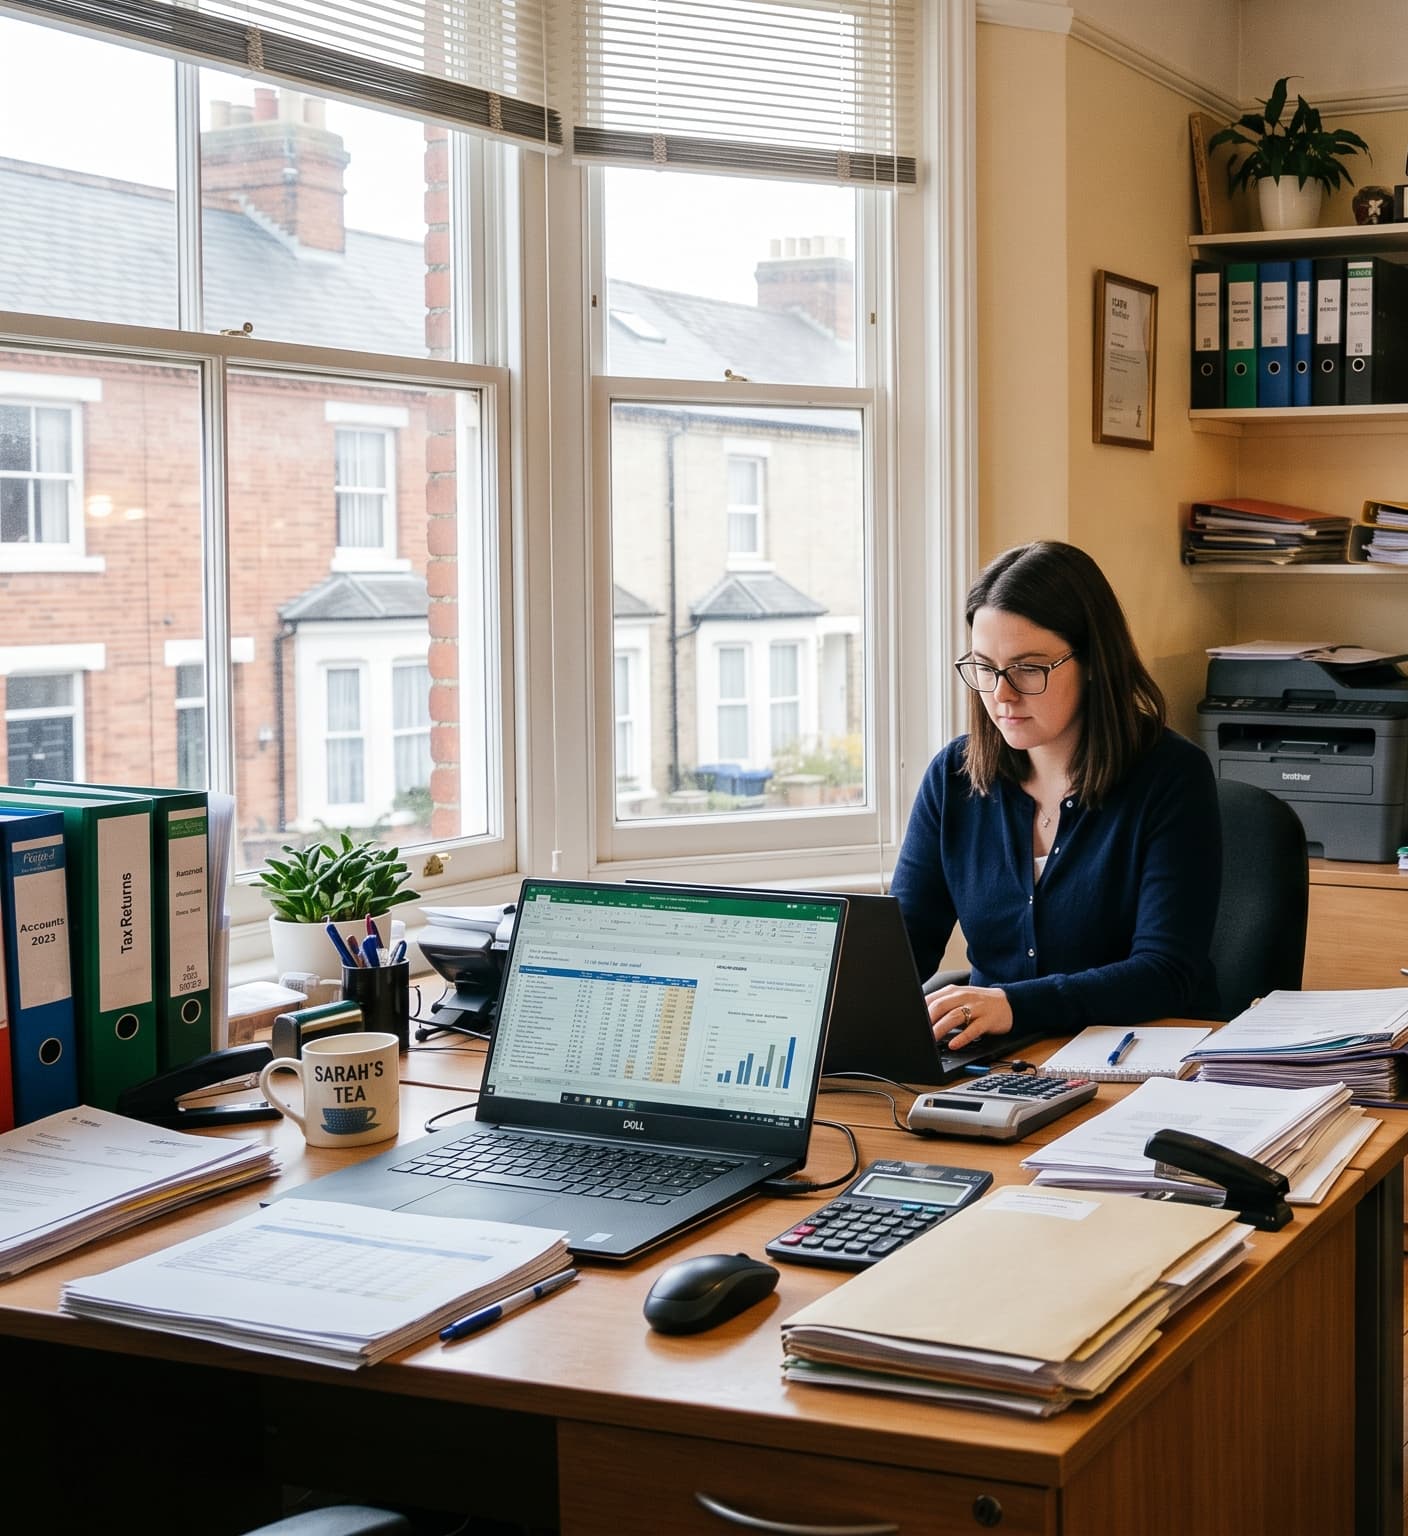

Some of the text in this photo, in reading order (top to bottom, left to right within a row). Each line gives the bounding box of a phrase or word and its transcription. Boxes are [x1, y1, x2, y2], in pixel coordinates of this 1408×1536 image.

[120, 872, 133, 954] Tax Returns
[20, 916, 65, 934] Accounts
[31, 933, 56, 946] 2023
[314, 1061, 384, 1082] SARAH'S
[333, 1085, 366, 1103] TEA
